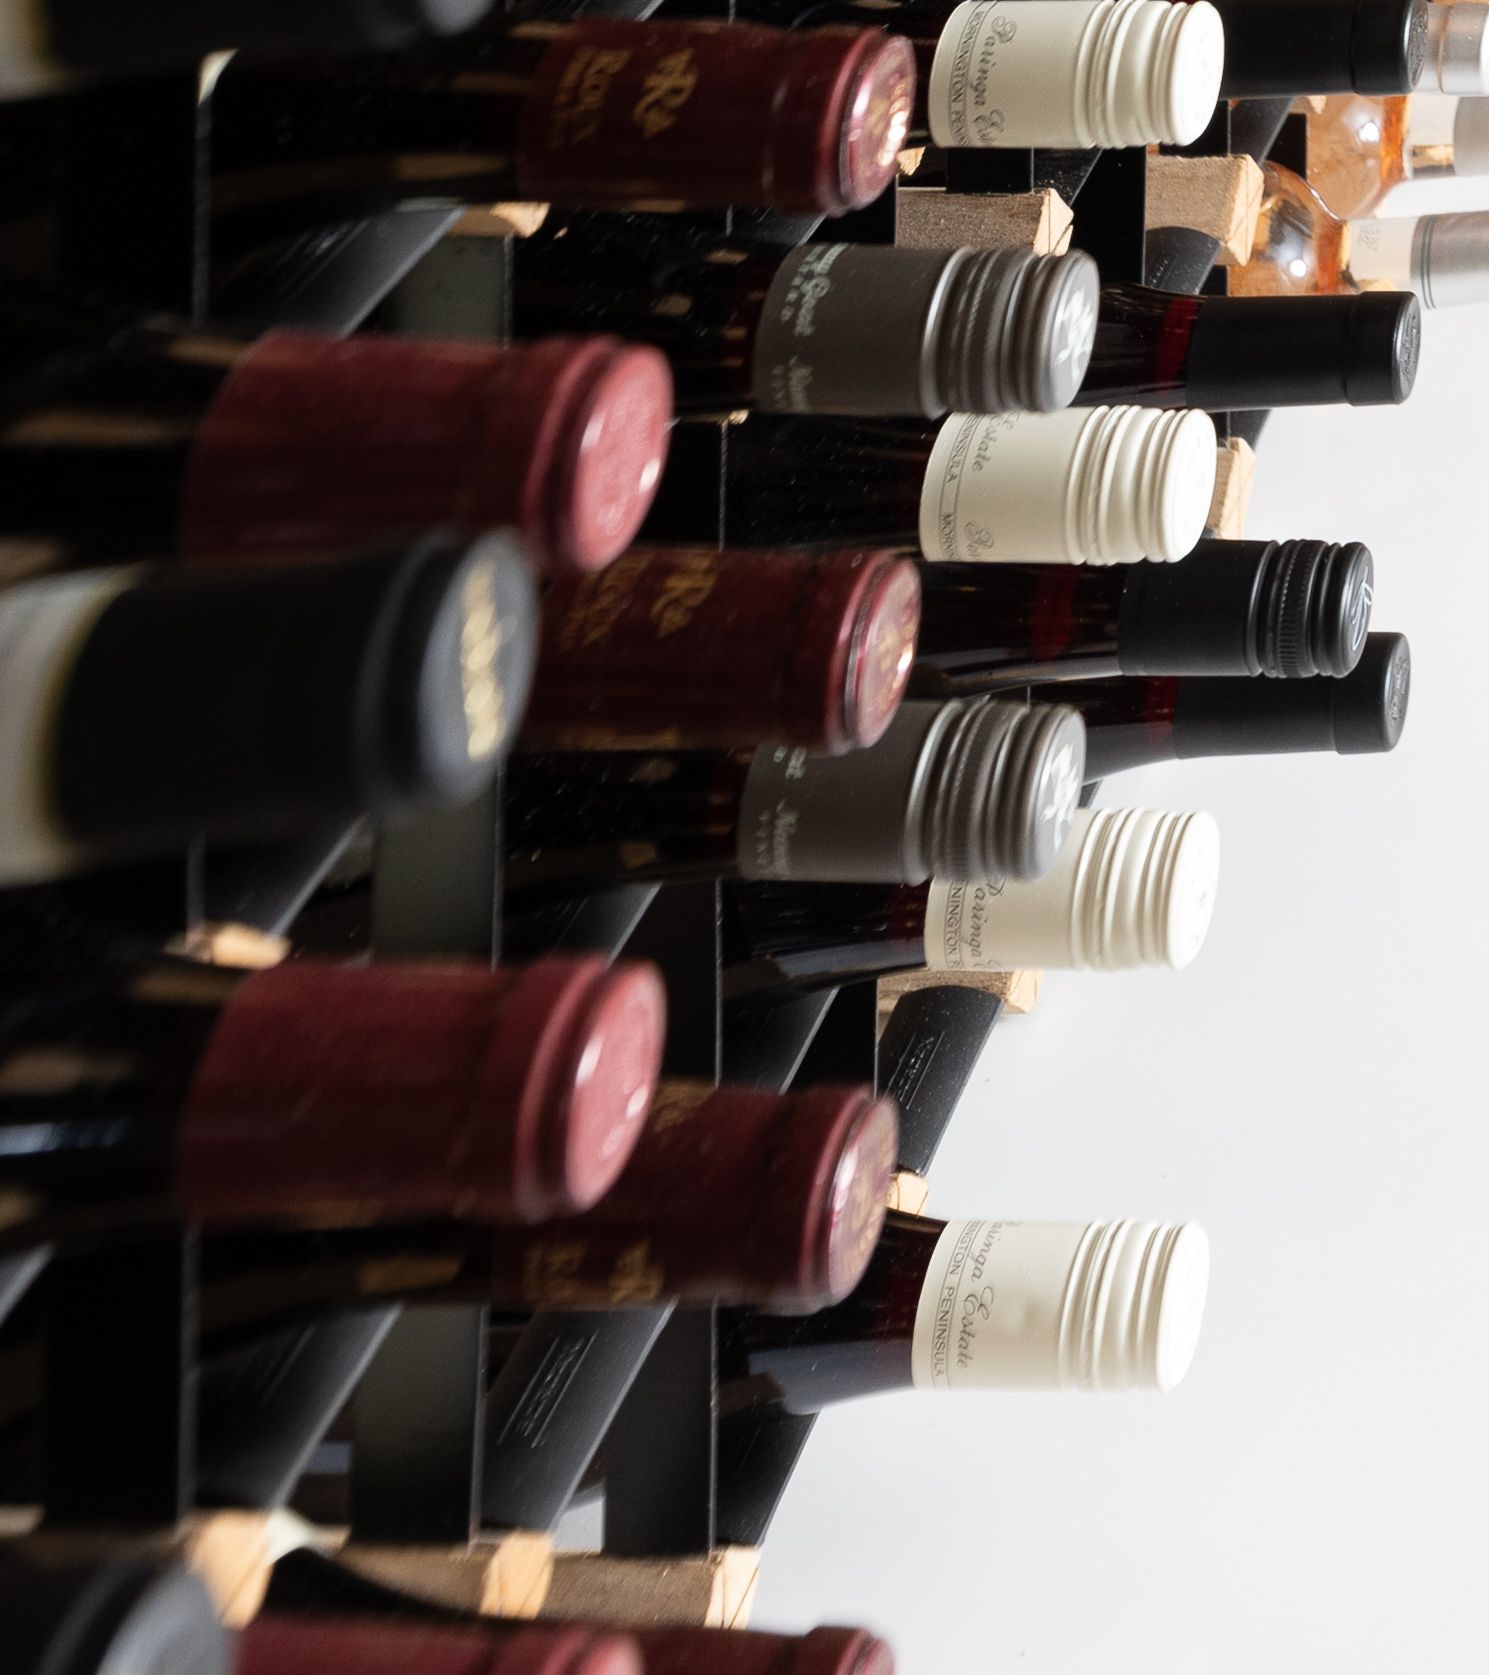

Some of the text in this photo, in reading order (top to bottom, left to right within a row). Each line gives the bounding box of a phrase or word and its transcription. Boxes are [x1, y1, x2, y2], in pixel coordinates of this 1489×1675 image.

[951, 11, 985, 102] MORNINGTON
[968, 15, 1018, 107] Paringa
[934, 1286, 956, 1377] PENINSULA
[957, 1285, 995, 1369] Estate
